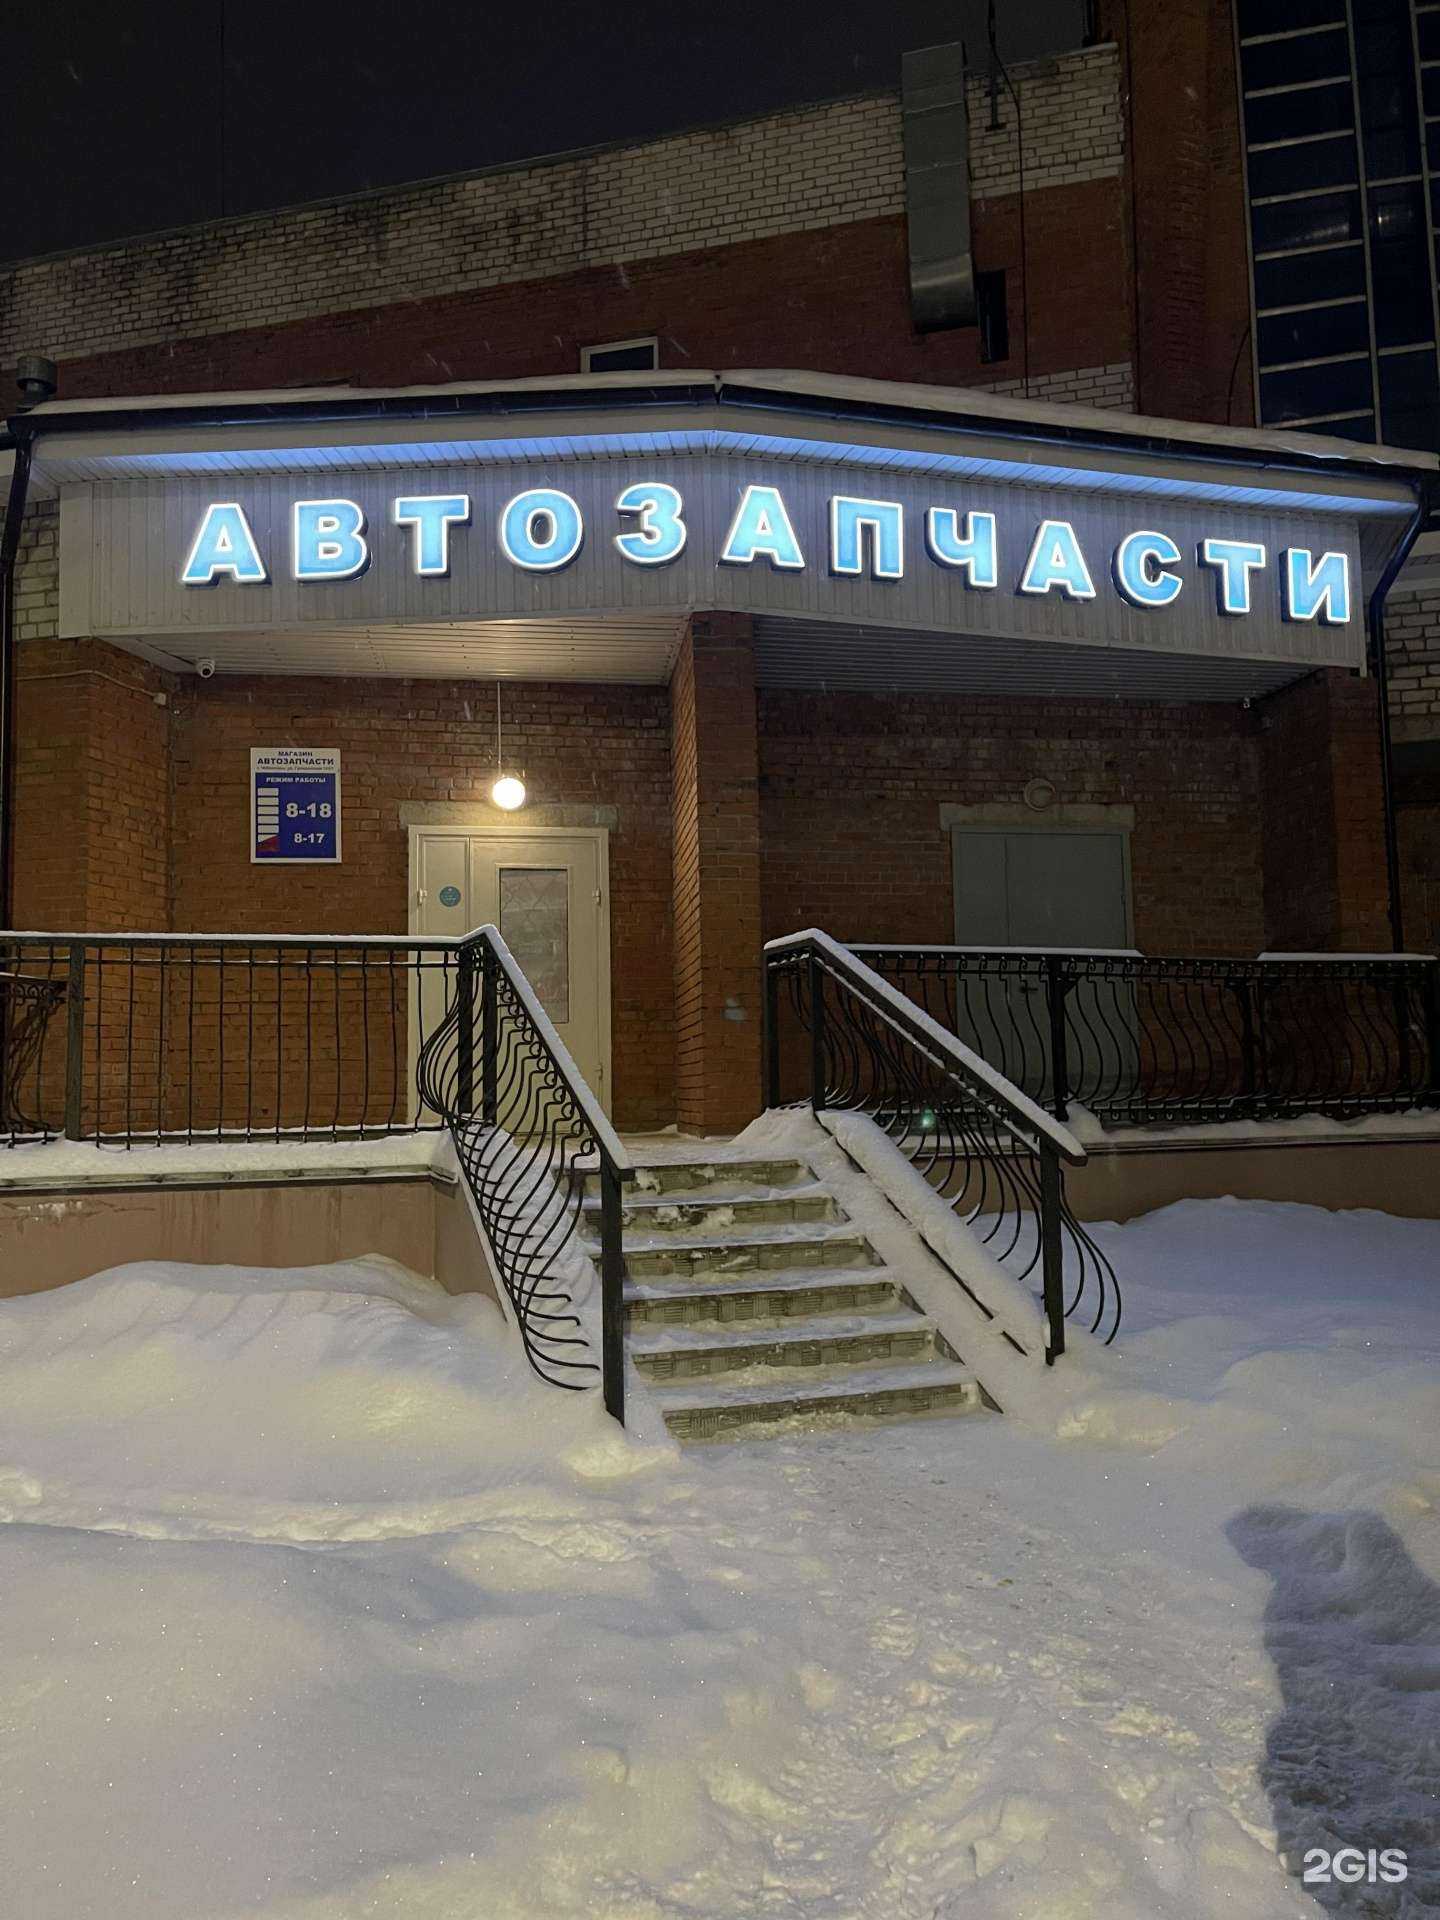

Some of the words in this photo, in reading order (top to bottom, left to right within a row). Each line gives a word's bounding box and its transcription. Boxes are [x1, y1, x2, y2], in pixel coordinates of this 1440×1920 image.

[180, 482, 1352, 624] АВТОЗАПЧАСТИ
[286, 802, 332, 818] 8-18
[294, 833, 325, 843] 8-17
